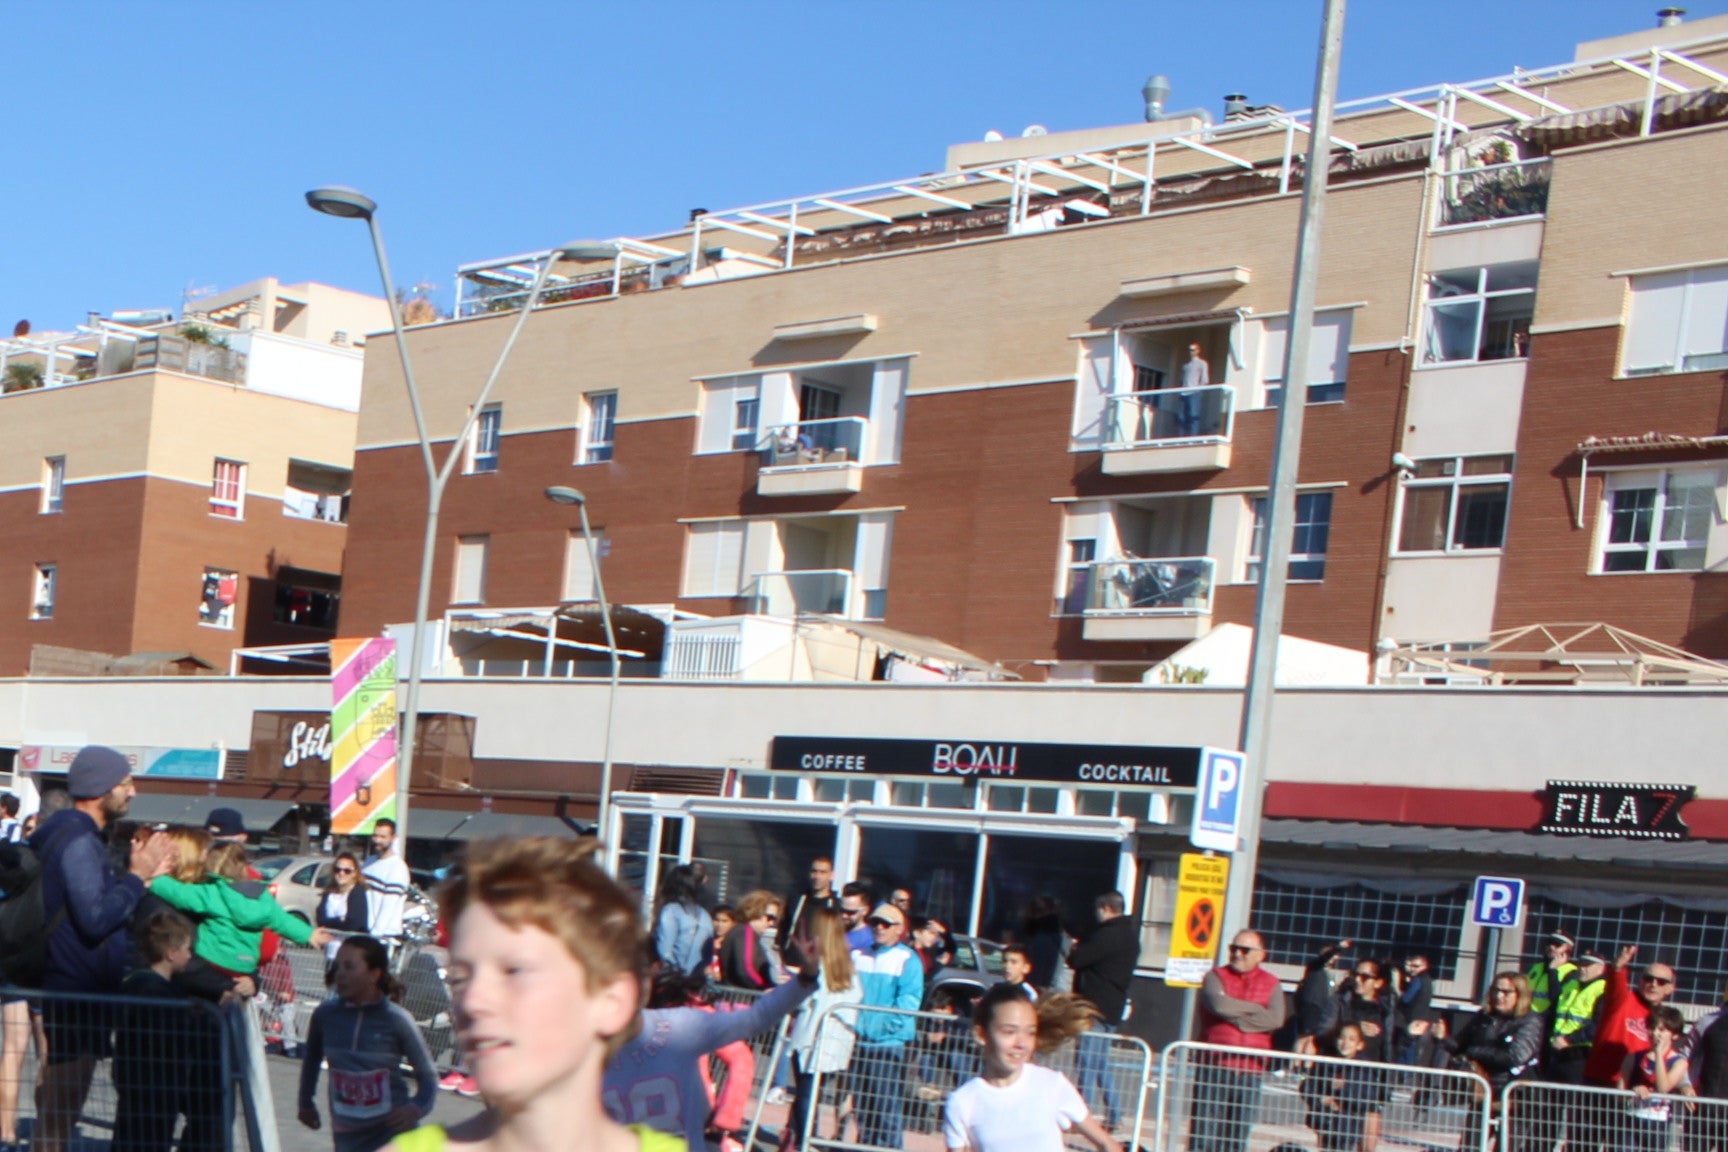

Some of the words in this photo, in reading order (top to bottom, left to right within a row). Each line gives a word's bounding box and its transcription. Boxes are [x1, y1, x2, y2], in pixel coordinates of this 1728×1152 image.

[800, 754, 866, 770] COFFEE
[1078, 763, 1172, 784] COCKTAIL
[1208, 757, 1238, 810] P
[1554, 792, 1638, 825] FILA
[1650, 791, 1678, 827] 7
[1480, 882, 1512, 921] P
